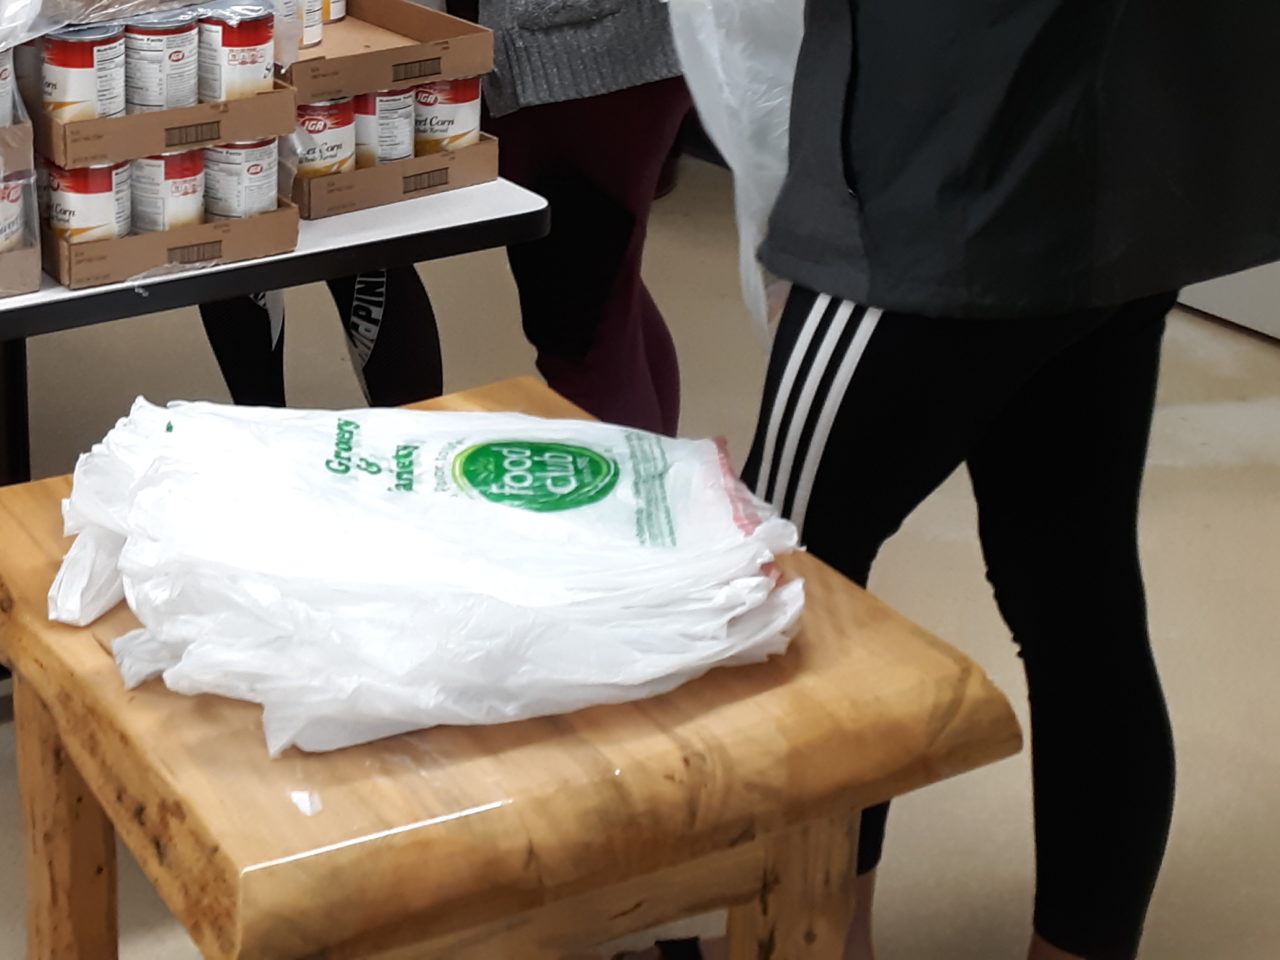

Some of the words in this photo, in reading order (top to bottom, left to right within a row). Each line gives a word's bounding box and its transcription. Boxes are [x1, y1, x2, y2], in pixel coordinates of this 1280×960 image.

[417, 92, 436, 105] IGA
[304, 120, 325, 132] IGA
[428, 115, 455, 127] Corn
[55, 204, 75, 216] Corn
[356, 457, 382, 475] &
[387, 444, 420, 492] ariety
[489, 446, 535, 496] food
[532, 451, 578, 495] club
